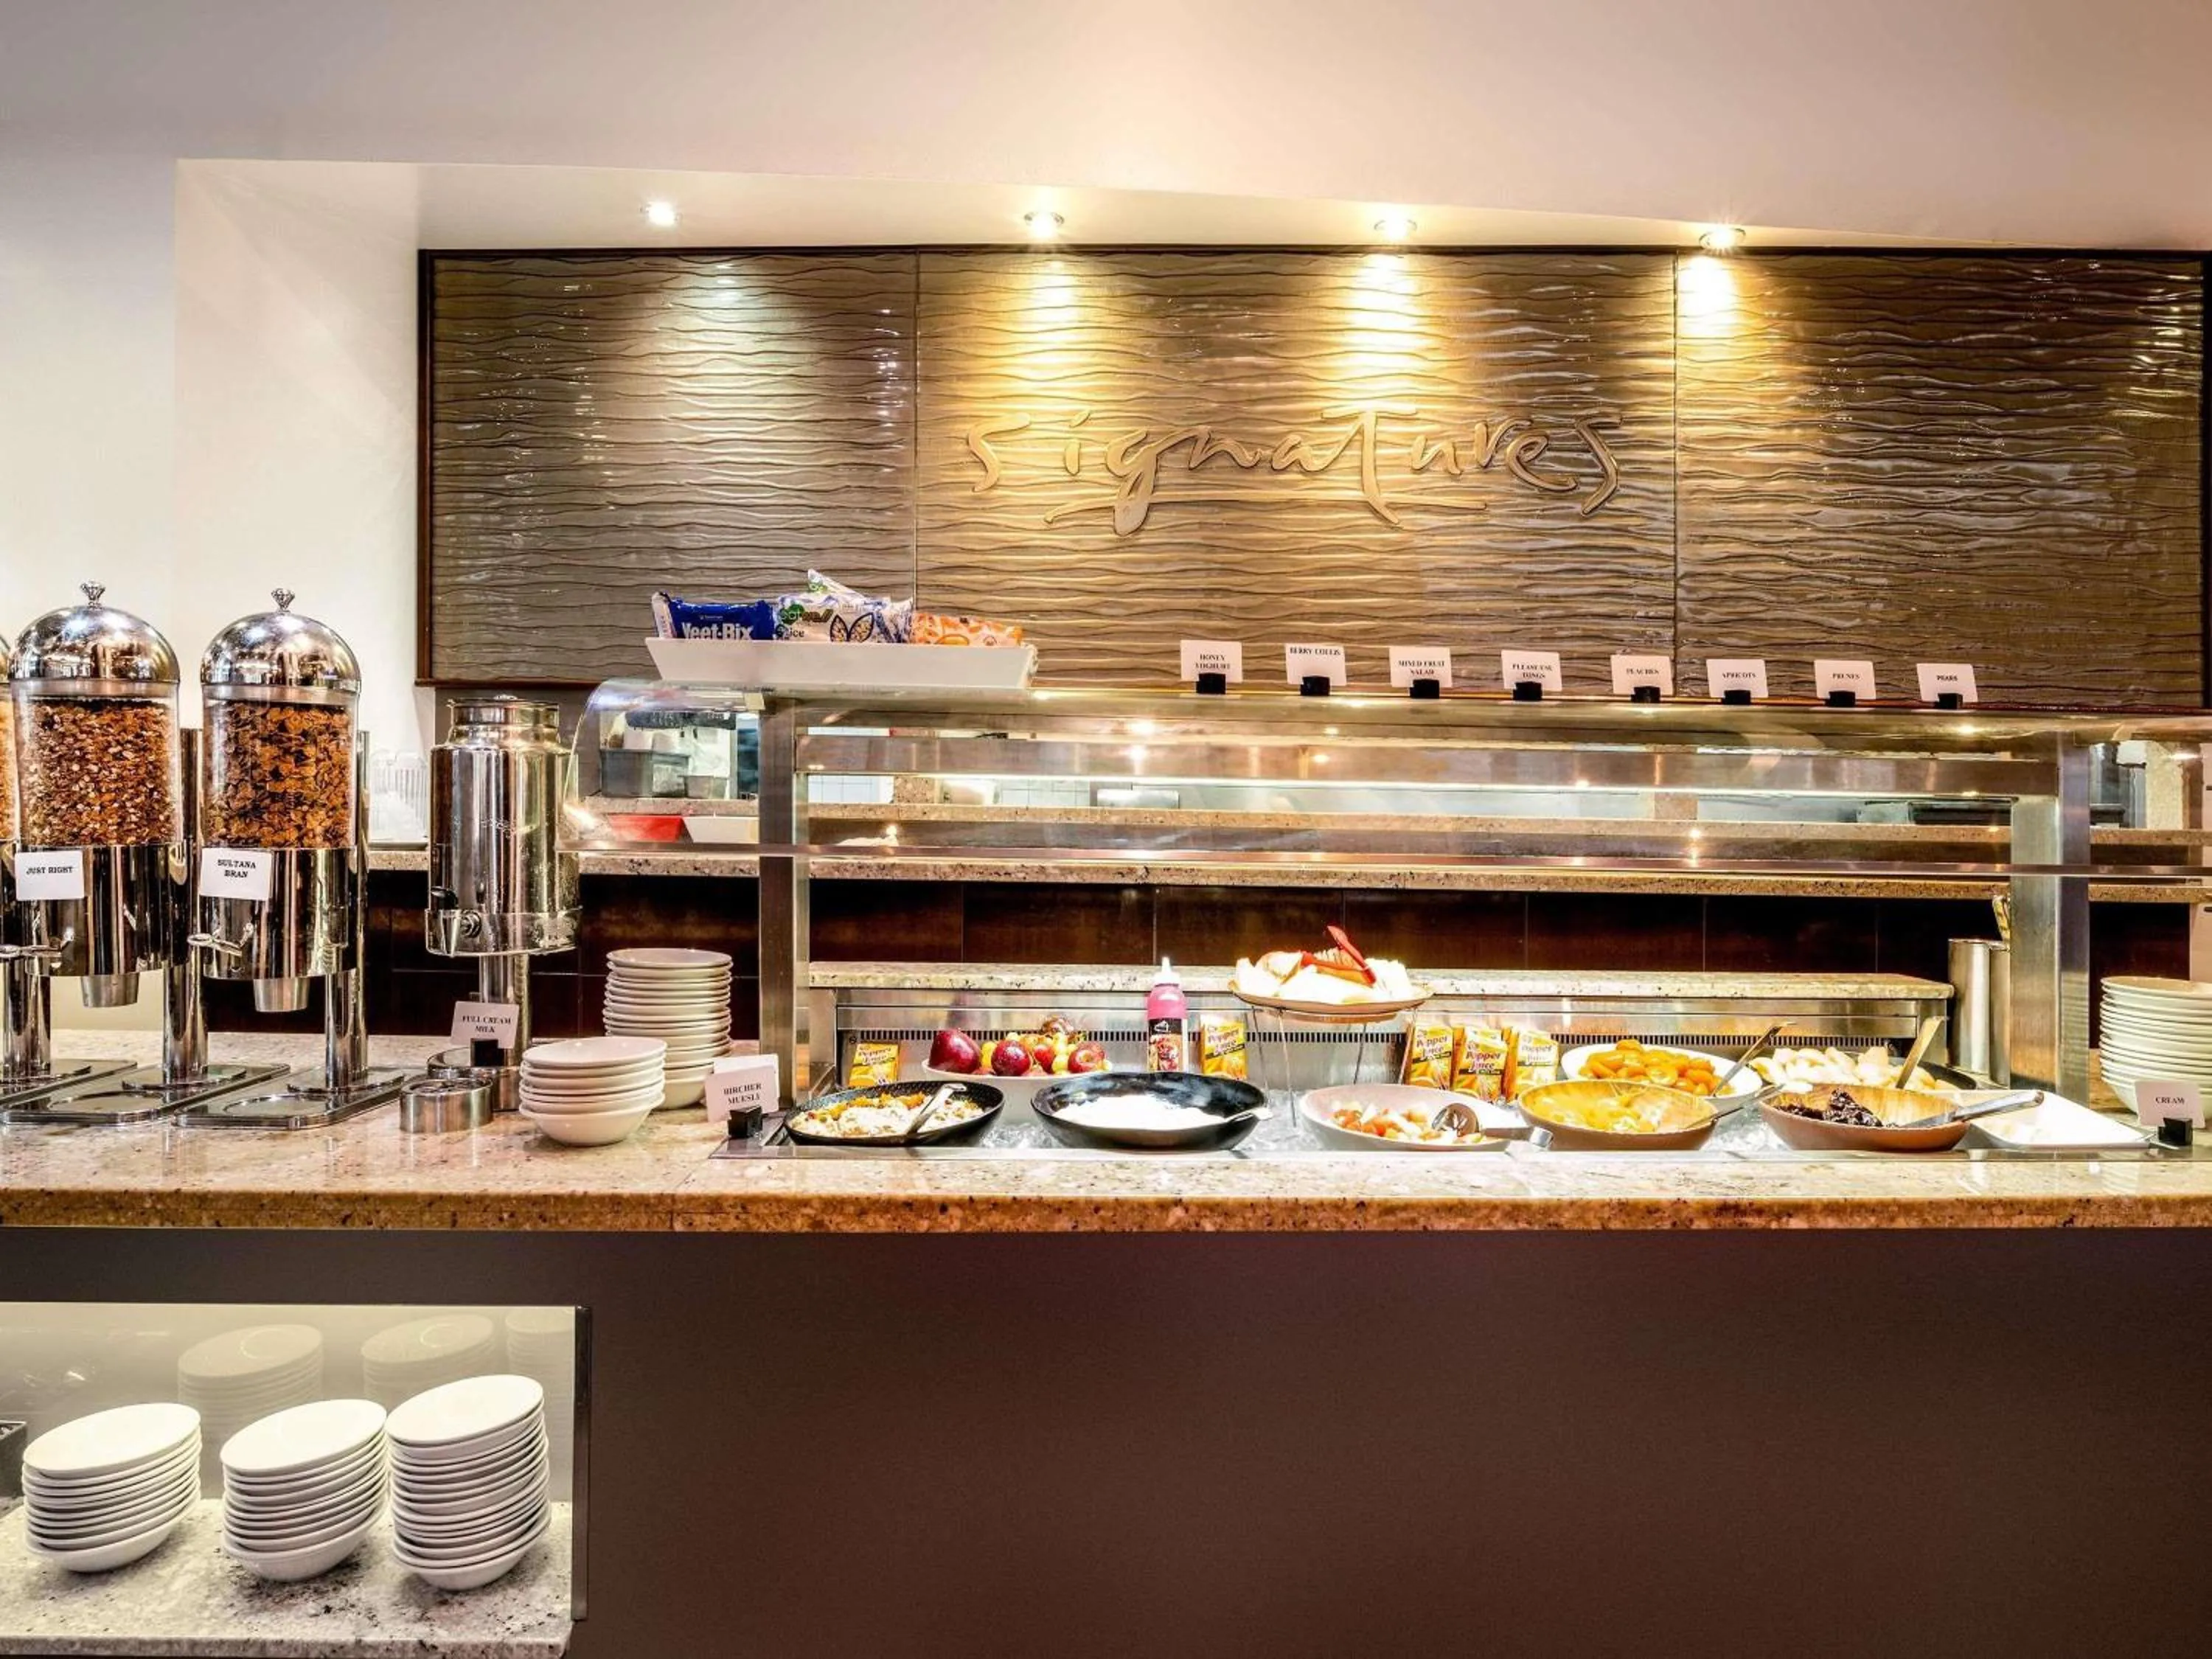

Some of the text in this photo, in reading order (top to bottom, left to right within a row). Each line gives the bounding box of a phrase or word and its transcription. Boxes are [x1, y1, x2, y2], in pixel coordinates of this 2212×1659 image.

[1200, 653, 1225, 661] HONEY
[218, 859, 257, 869] SULTANA
[27, 866, 73, 875] JUST RIGHT
[223, 869, 248, 879] BRAN
[483, 1016, 511, 1024] CREAM
[723, 1082, 762, 1095] BIRCHER
[728, 1092, 760, 1104] MUESLI
[2155, 1096, 2185, 1105] CREAM
